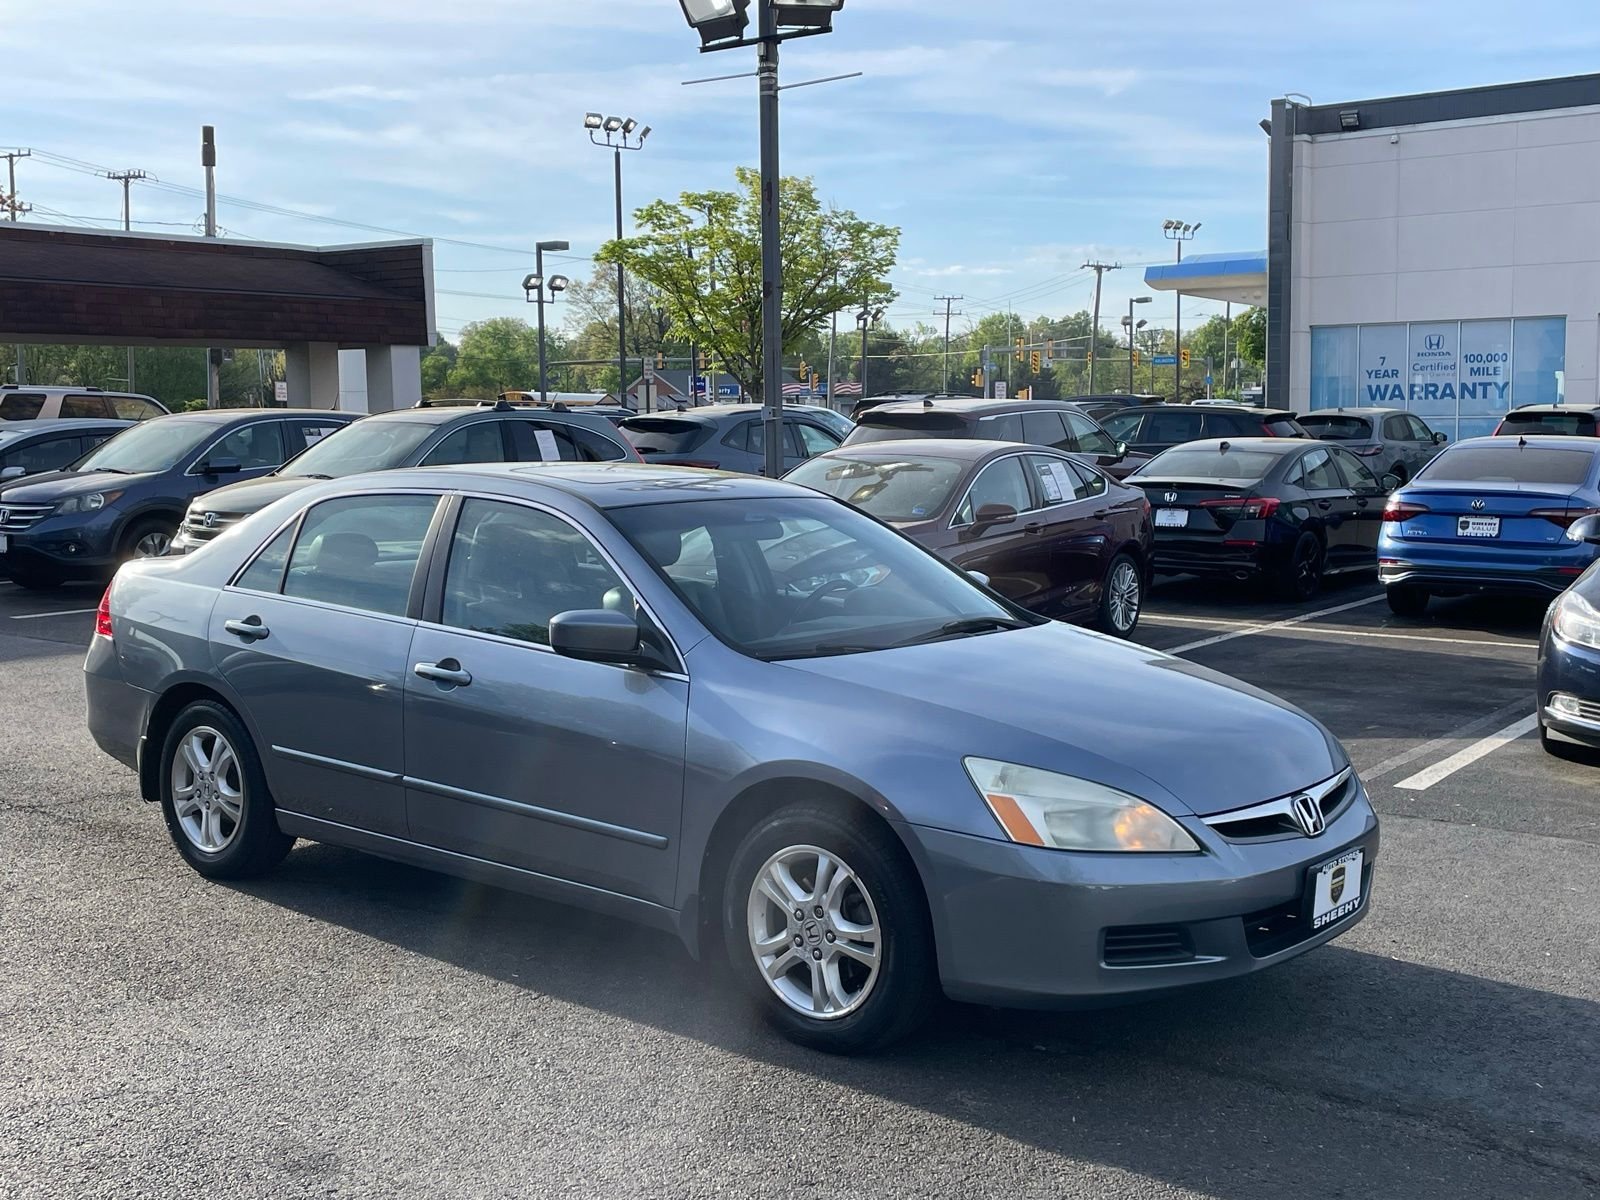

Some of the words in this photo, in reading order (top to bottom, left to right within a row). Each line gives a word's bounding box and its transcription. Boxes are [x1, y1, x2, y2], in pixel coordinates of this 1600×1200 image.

[1379, 356, 1386, 366] 7
[1463, 353, 1508, 364] 100,000
[1412, 362, 1456, 372] Certified
[1470, 366, 1501, 377] MILE
[1366, 369, 1399, 379] YEAR
[1367, 382, 1509, 400] WARRANTY
[1322, 860, 1337, 873] AUTO
[1313, 896, 1361, 929] SHEEHY
